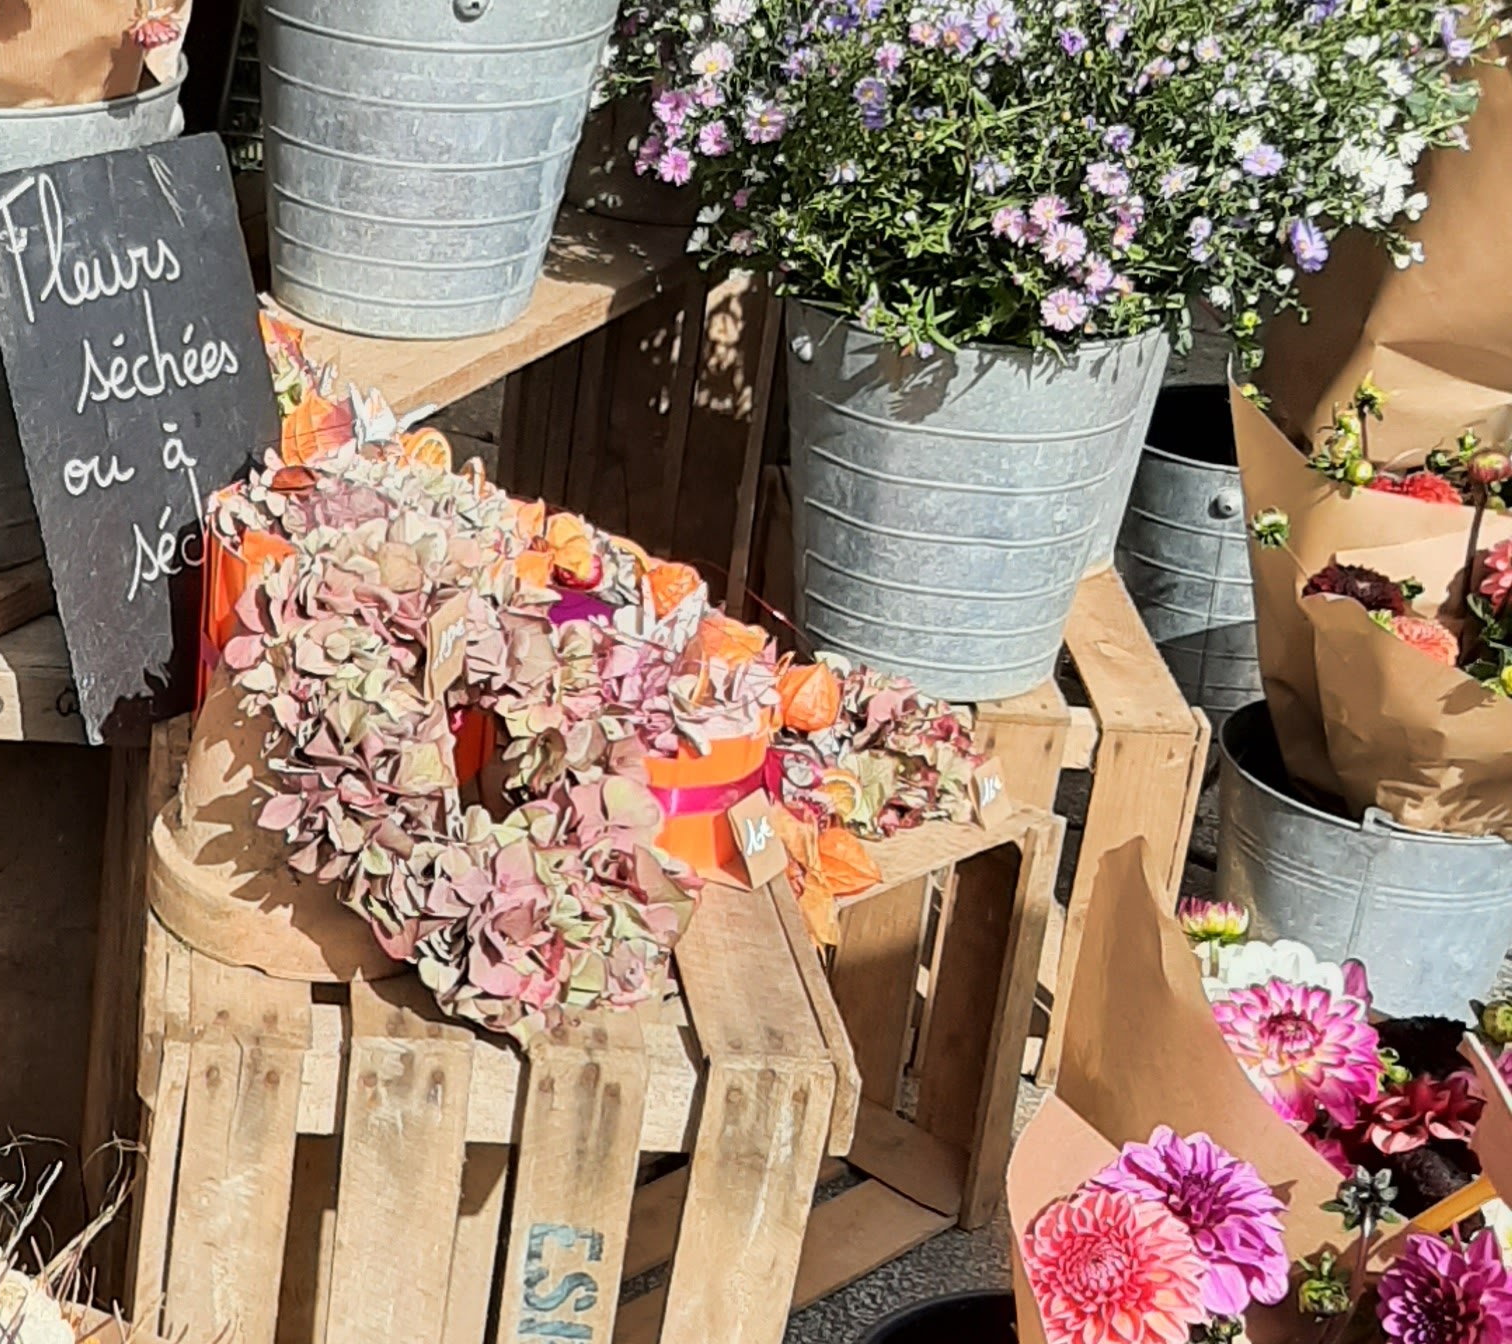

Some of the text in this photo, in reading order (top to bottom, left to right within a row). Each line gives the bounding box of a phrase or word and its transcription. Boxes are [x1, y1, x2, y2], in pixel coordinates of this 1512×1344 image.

[76, 289, 241, 415] séchées
[63, 423, 198, 497] ou à
